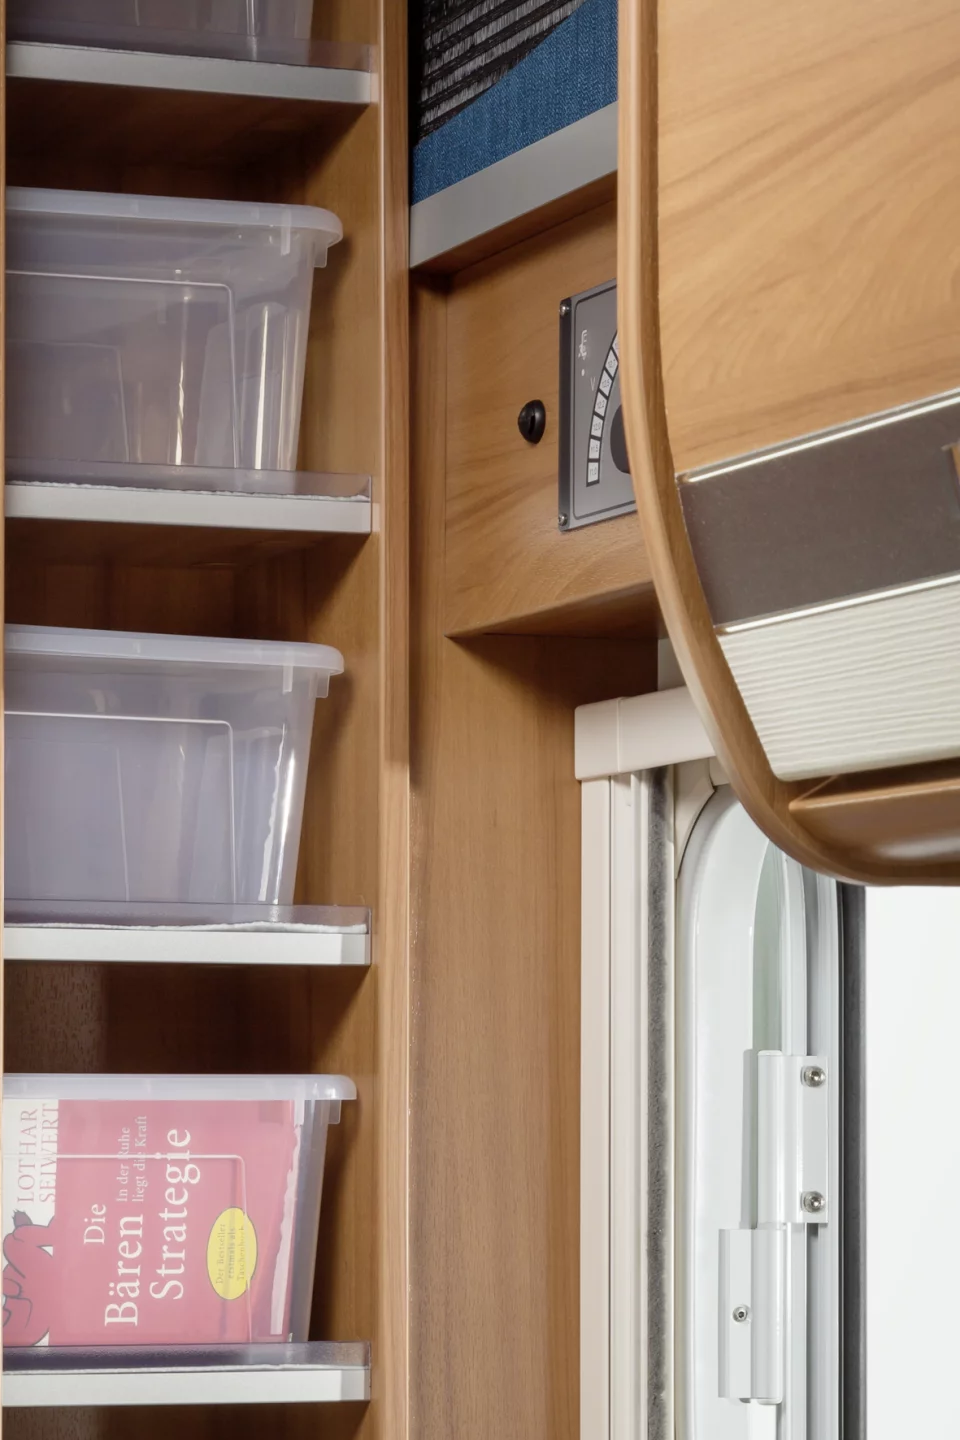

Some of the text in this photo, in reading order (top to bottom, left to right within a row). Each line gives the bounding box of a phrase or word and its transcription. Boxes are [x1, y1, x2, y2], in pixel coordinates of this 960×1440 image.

[17, 1108, 38, 1203] LOTHAR
[38, 1103, 59, 1203] SEIWERT
[116, 1126, 130, 1202] In der Ruhe
[135, 1116, 147, 1147] Kraft
[83, 1203, 107, 1245] Die
[132, 1175, 148, 1202] liegt
[149, 1128, 201, 1300] Strategie
[104, 1214, 144, 1327] Bären
[215, 1223, 226, 1284] Der Bestseller
